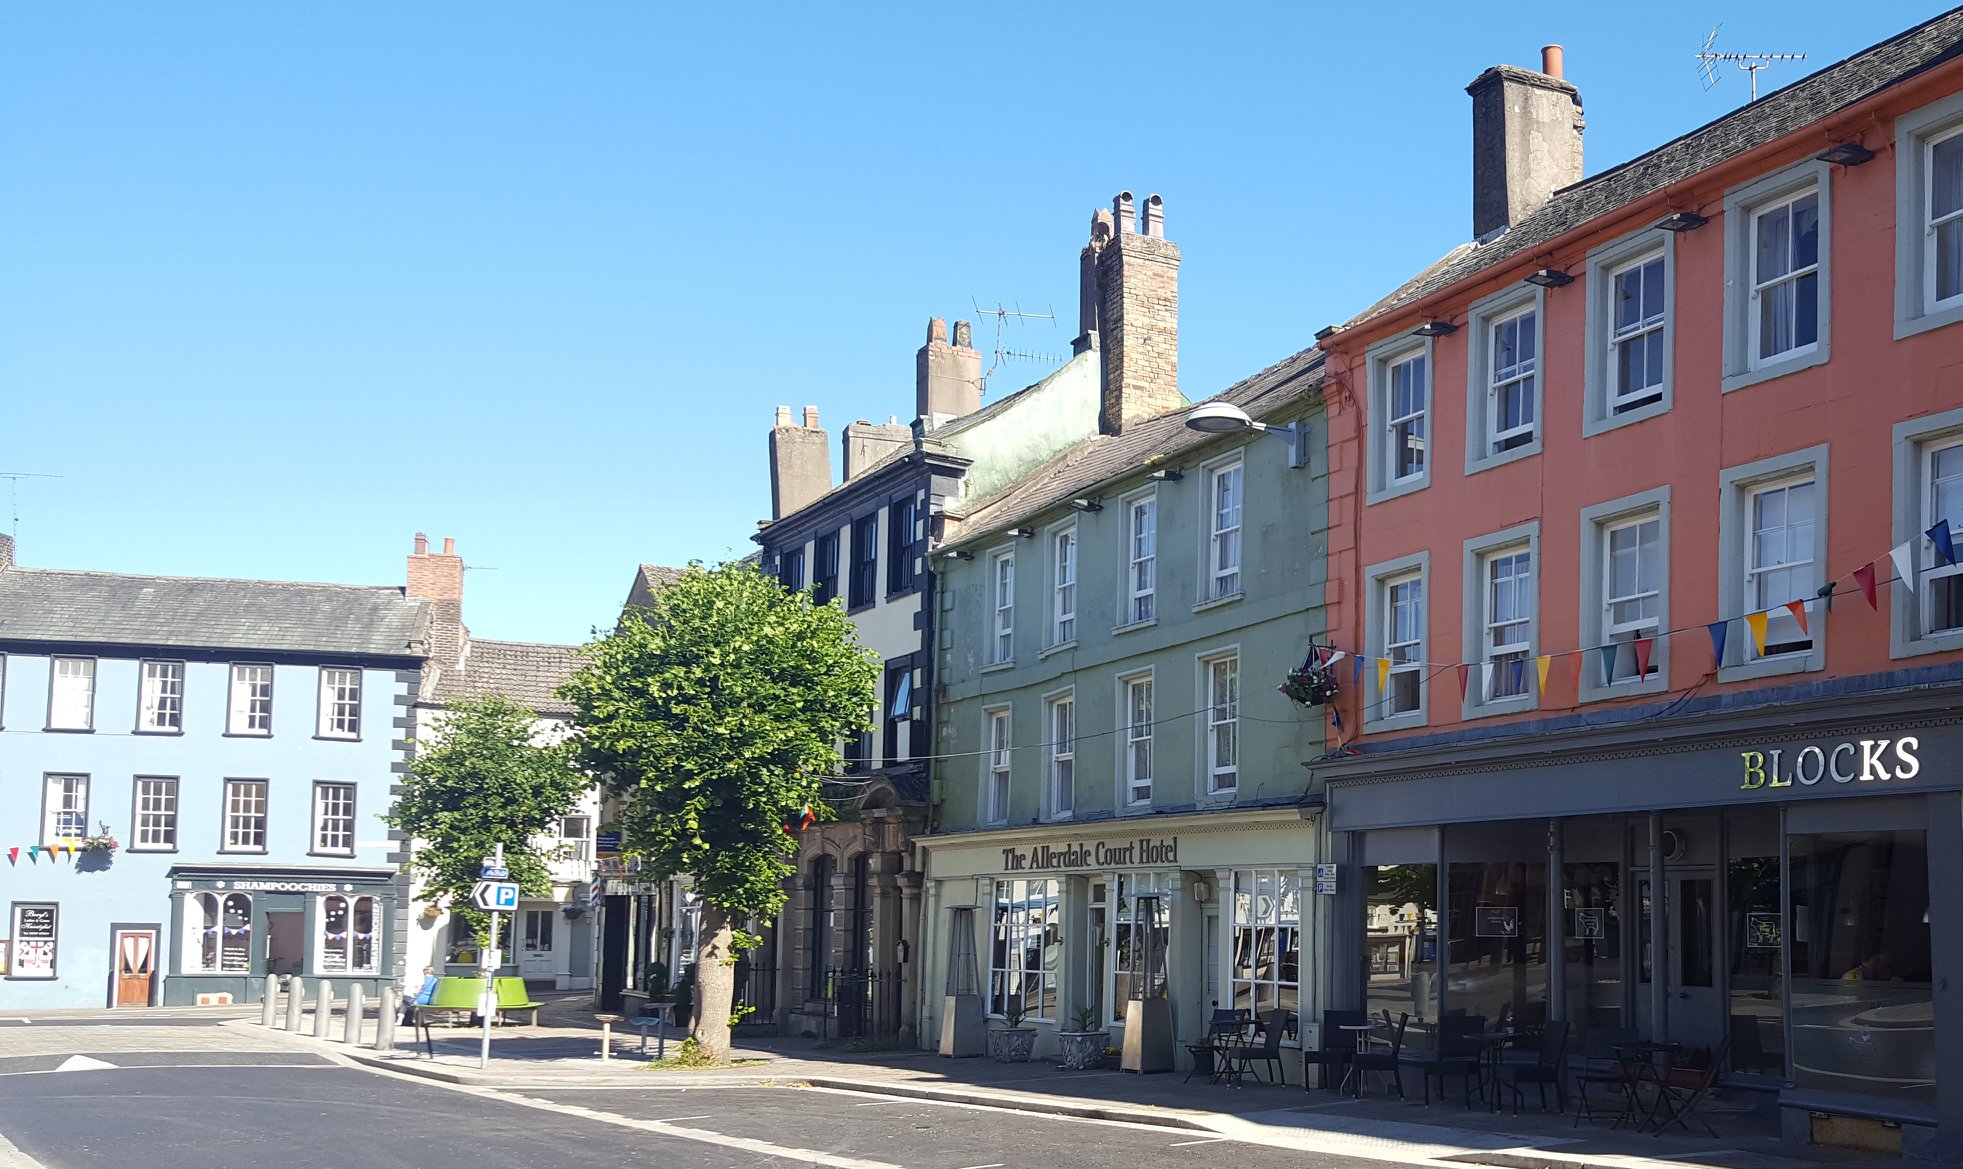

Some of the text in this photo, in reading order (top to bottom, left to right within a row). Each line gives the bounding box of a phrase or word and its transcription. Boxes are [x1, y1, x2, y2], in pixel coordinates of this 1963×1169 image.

[1740, 736, 1920, 790] BLOCKS
[1002, 836, 1178, 871] The Allerdale Court Hotel
[233, 881, 337, 892] SHAMPOOCHIES
[499, 888, 514, 905] P
